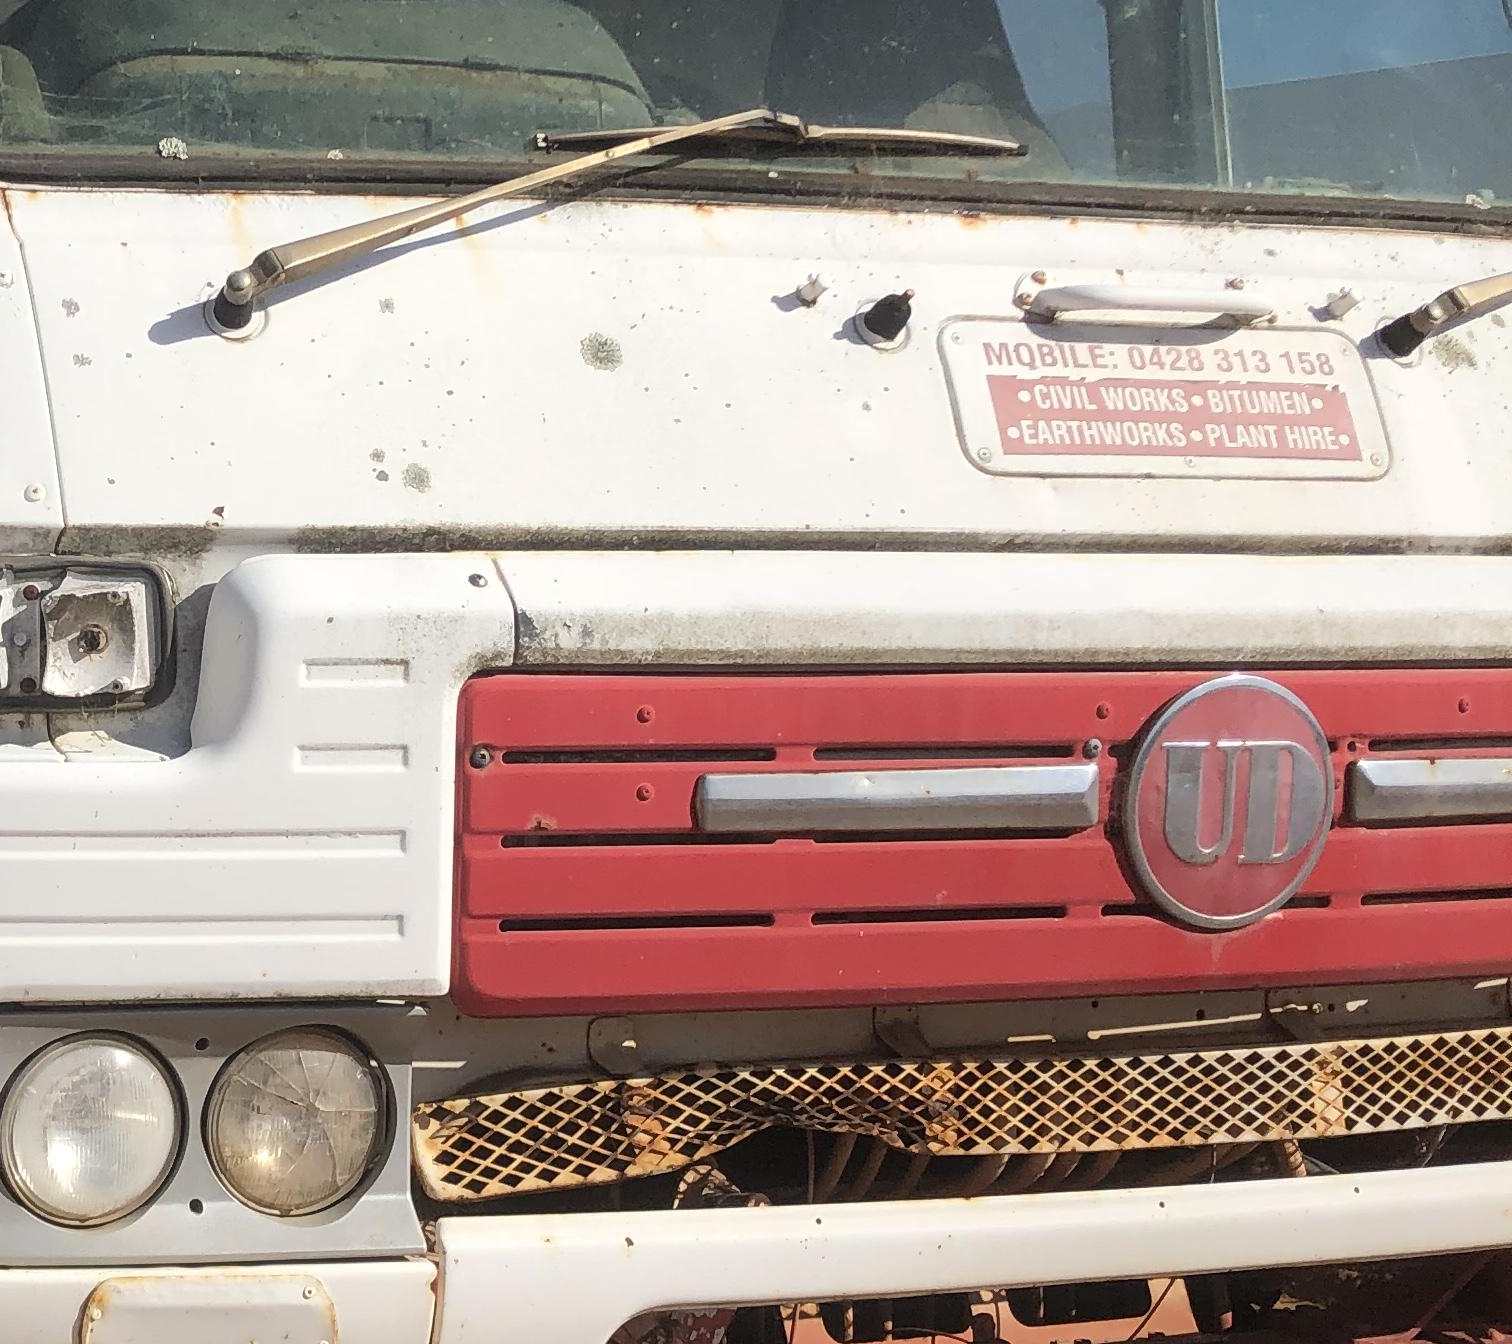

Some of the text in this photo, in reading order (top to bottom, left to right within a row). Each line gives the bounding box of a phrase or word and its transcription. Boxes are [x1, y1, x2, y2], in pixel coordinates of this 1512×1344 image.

[1127, 346, 1205, 371] 0428
[1213, 349, 1270, 373] 313
[1279, 351, 1334, 375] 158
[1034, 384, 1311, 415] CIVIL WORKS BITUMEN
[1020, 420, 1339, 449] EARTHWORKS PLANT HIRE
[1162, 739, 1324, 864] UD
